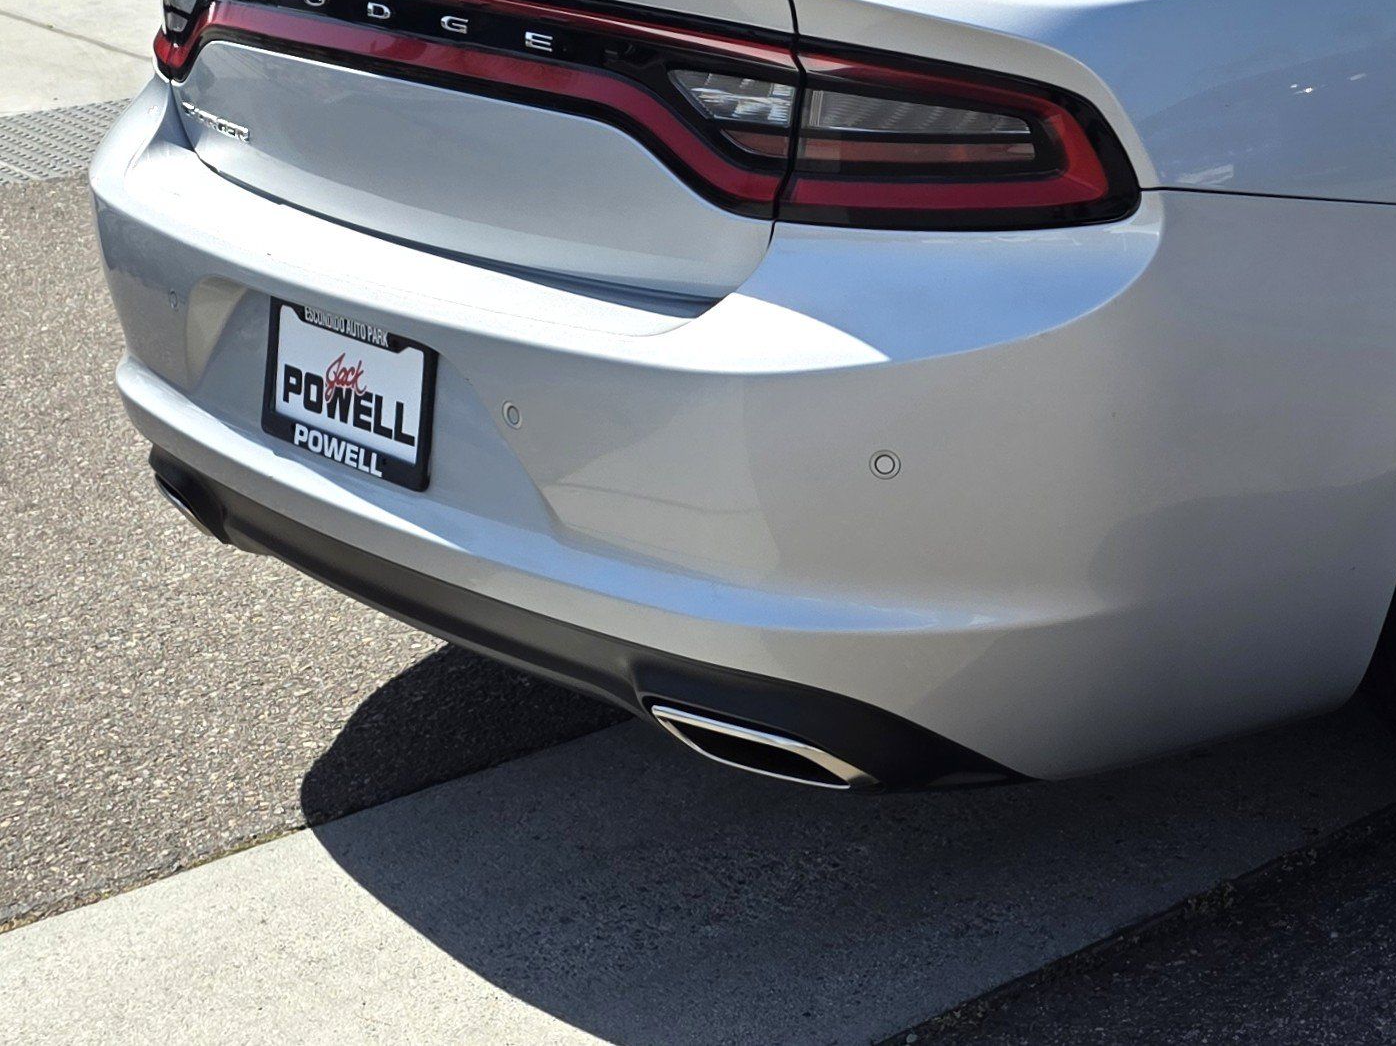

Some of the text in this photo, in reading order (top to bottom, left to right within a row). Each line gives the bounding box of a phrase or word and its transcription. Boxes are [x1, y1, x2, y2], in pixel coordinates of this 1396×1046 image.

[346, 318, 366, 340] AUTO
[367, 325, 389, 348] PARK
[325, 353, 367, 402] Jack
[282, 364, 415, 447] POWELL
[293, 424, 383, 478] POWELL
